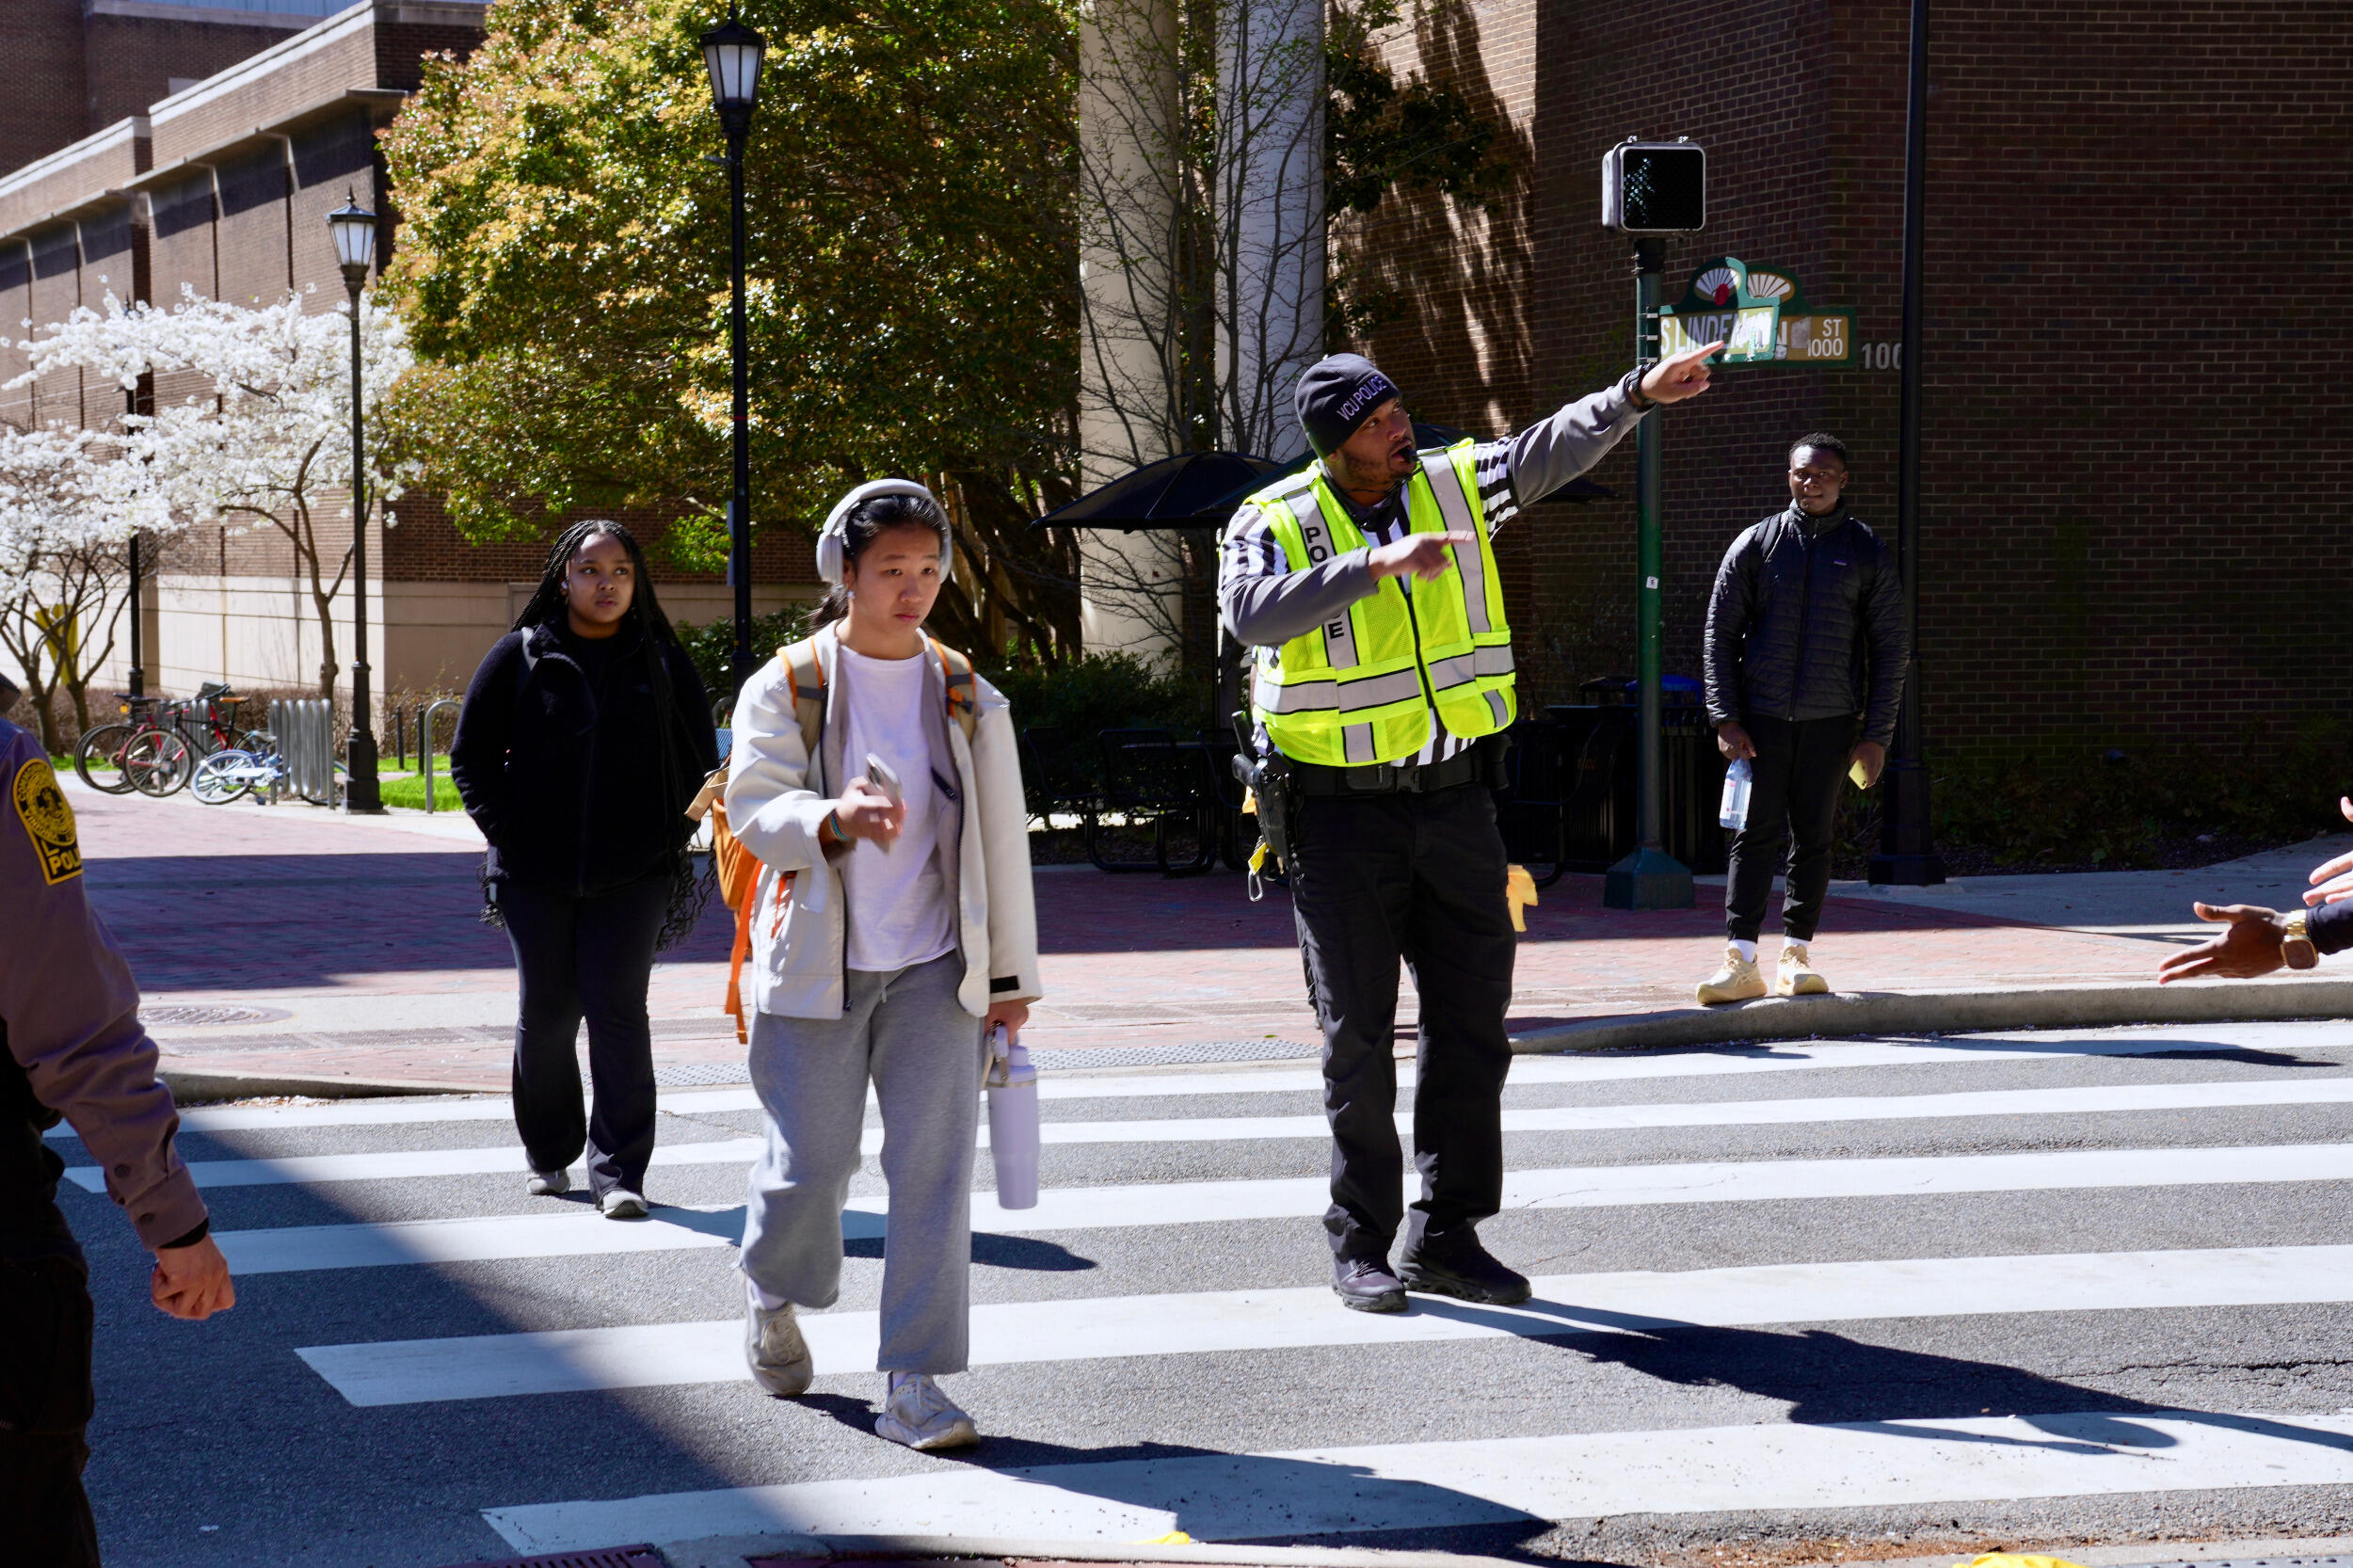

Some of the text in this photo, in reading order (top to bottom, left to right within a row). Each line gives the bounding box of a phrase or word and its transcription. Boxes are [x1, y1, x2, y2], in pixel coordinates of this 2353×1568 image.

[1660, 317, 1671, 356] S
[1674, 312, 1748, 354] LINDEN
[1807, 338, 1843, 358] 1000
[1822, 318, 1842, 337] ST
[1337, 376, 1386, 421] VCU POLICE
[1305, 526, 1344, 640] POE
